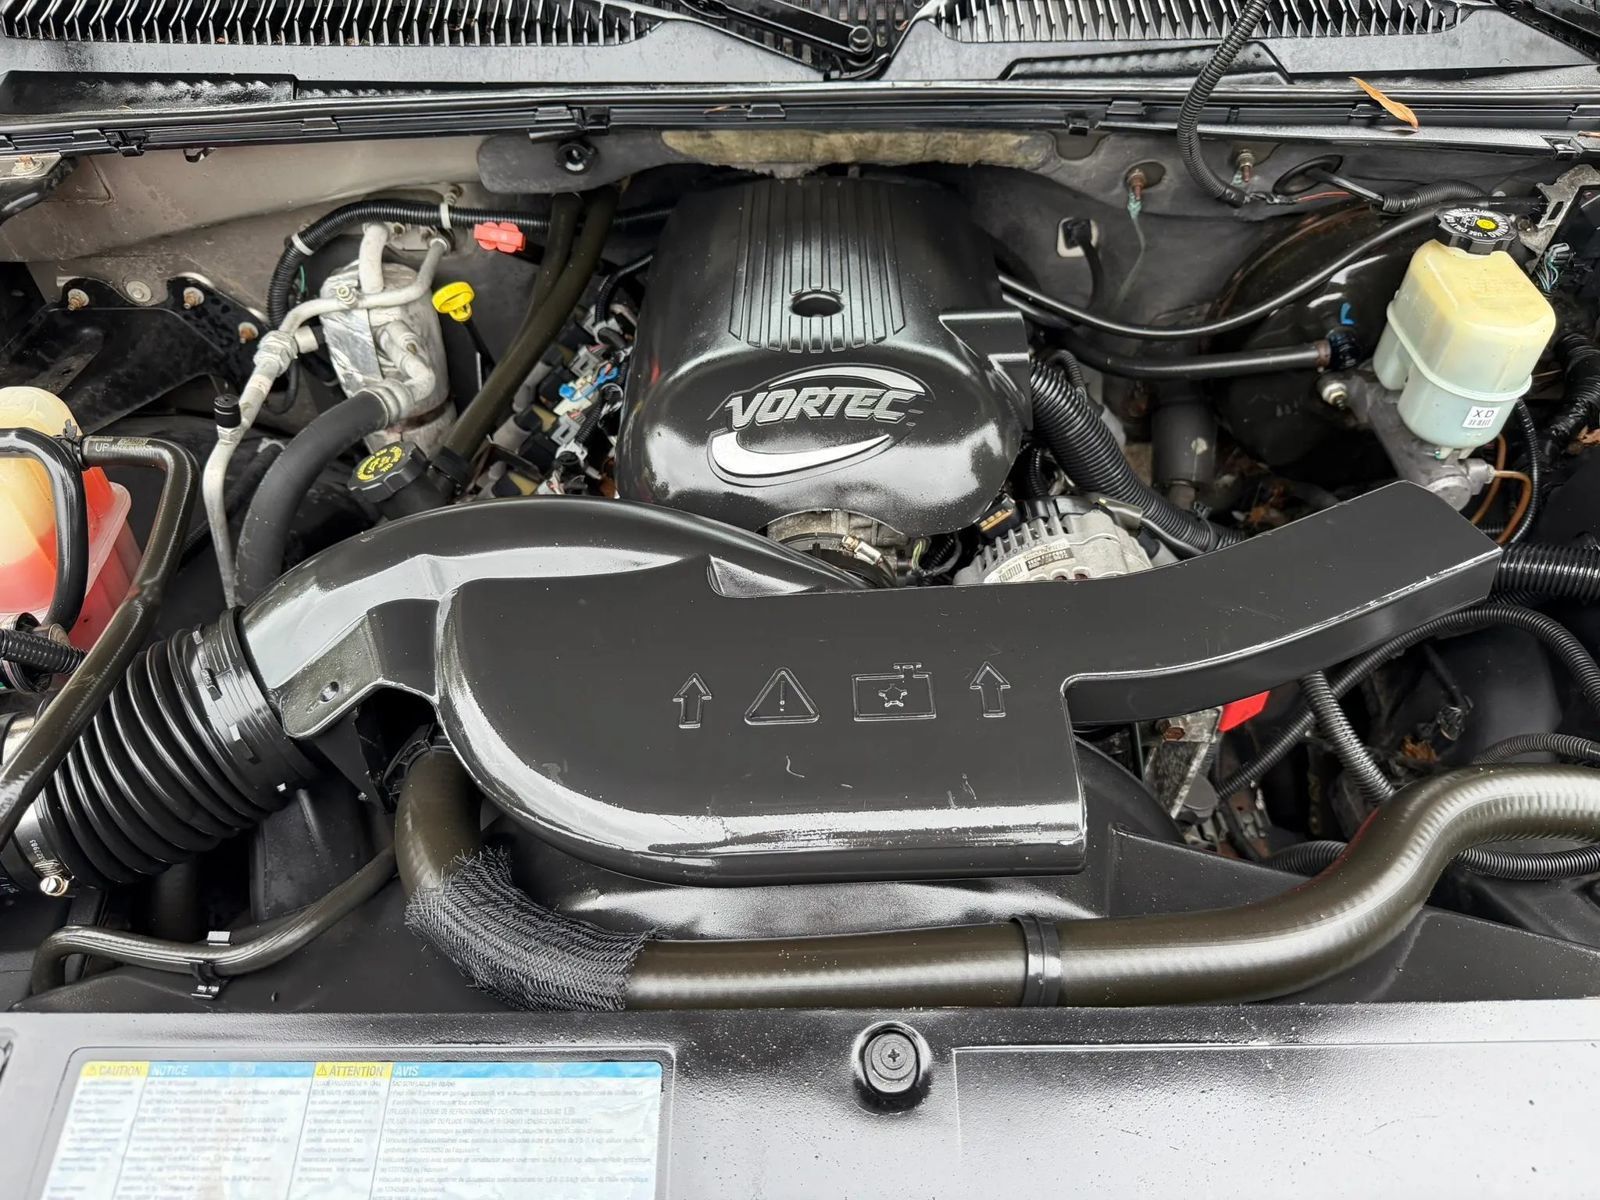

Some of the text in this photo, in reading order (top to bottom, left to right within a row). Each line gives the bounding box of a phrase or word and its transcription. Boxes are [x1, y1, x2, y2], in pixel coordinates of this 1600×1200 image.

[725, 386, 918, 431] VORTEC
[95, 442, 109, 452] UP
[99, 1065, 143, 1076] CAUTION
[151, 1065, 190, 1076] NOTICE
[328, 1065, 384, 1077] ATTENTION
[394, 1065, 420, 1077] AVIS
